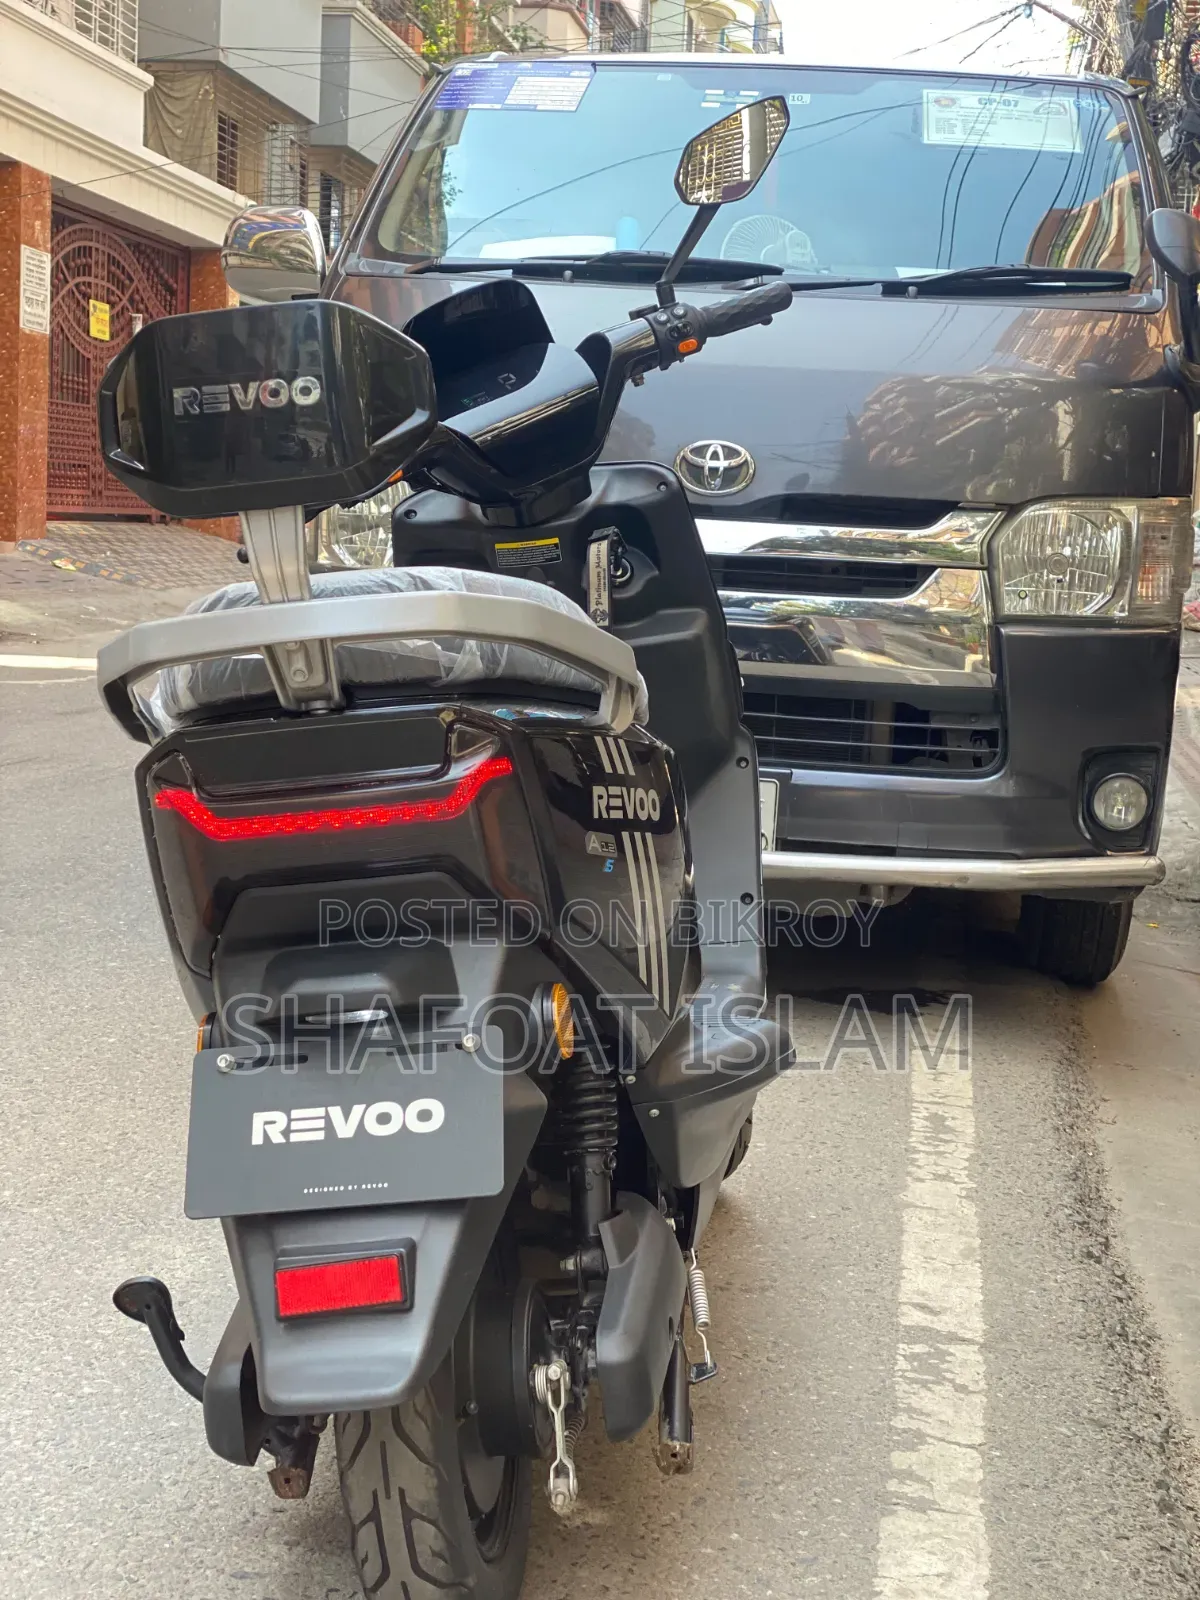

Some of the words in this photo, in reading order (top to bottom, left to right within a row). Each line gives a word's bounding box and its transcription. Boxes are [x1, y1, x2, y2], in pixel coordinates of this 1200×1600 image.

[172, 376, 321, 416] REVOO
[595, 542, 603, 569] Motors
[595, 570, 604, 607] Platinum
[592, 785, 661, 822] REVOO
[251, 1098, 445, 1146] REVOO
